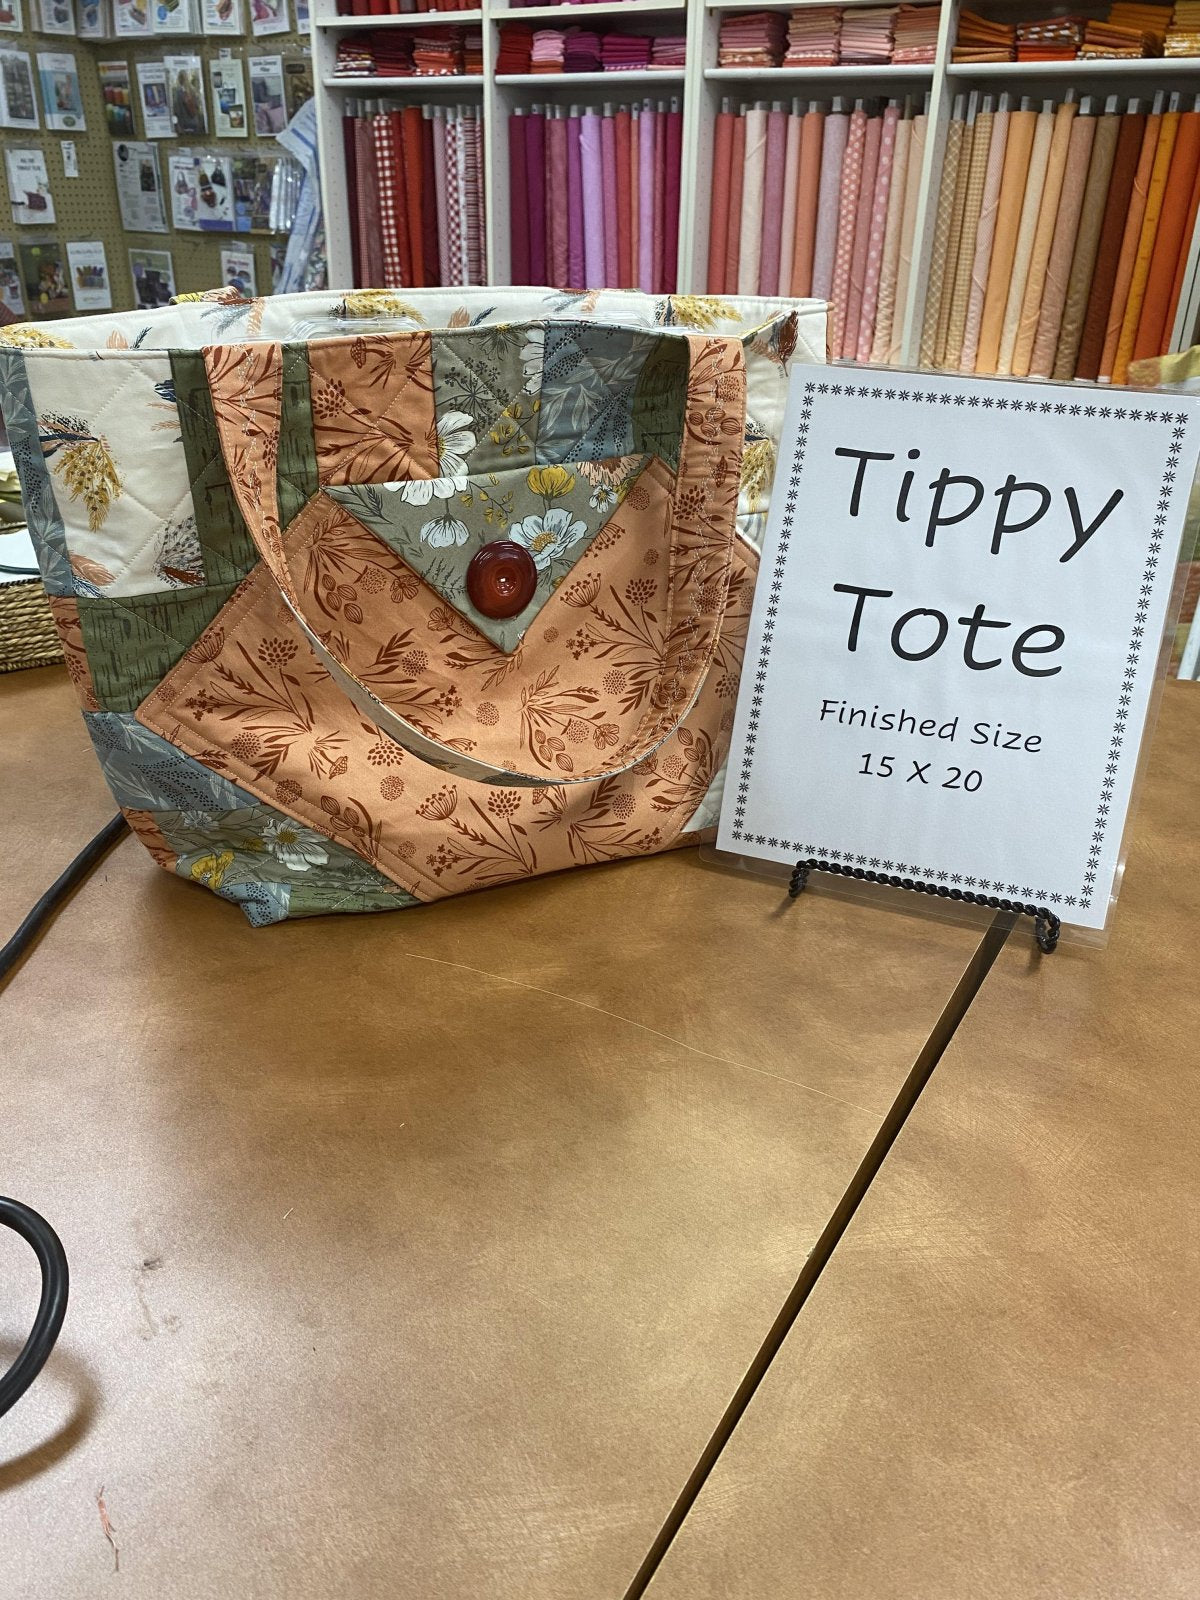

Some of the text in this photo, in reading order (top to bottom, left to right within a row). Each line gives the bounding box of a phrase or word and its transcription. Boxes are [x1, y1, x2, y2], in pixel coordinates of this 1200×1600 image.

[834, 447, 1124, 563] Tippy
[833, 583, 1066, 678] Tote
[819, 699, 1042, 753] Finished Size
[858, 753, 983, 793] 15 X 20
